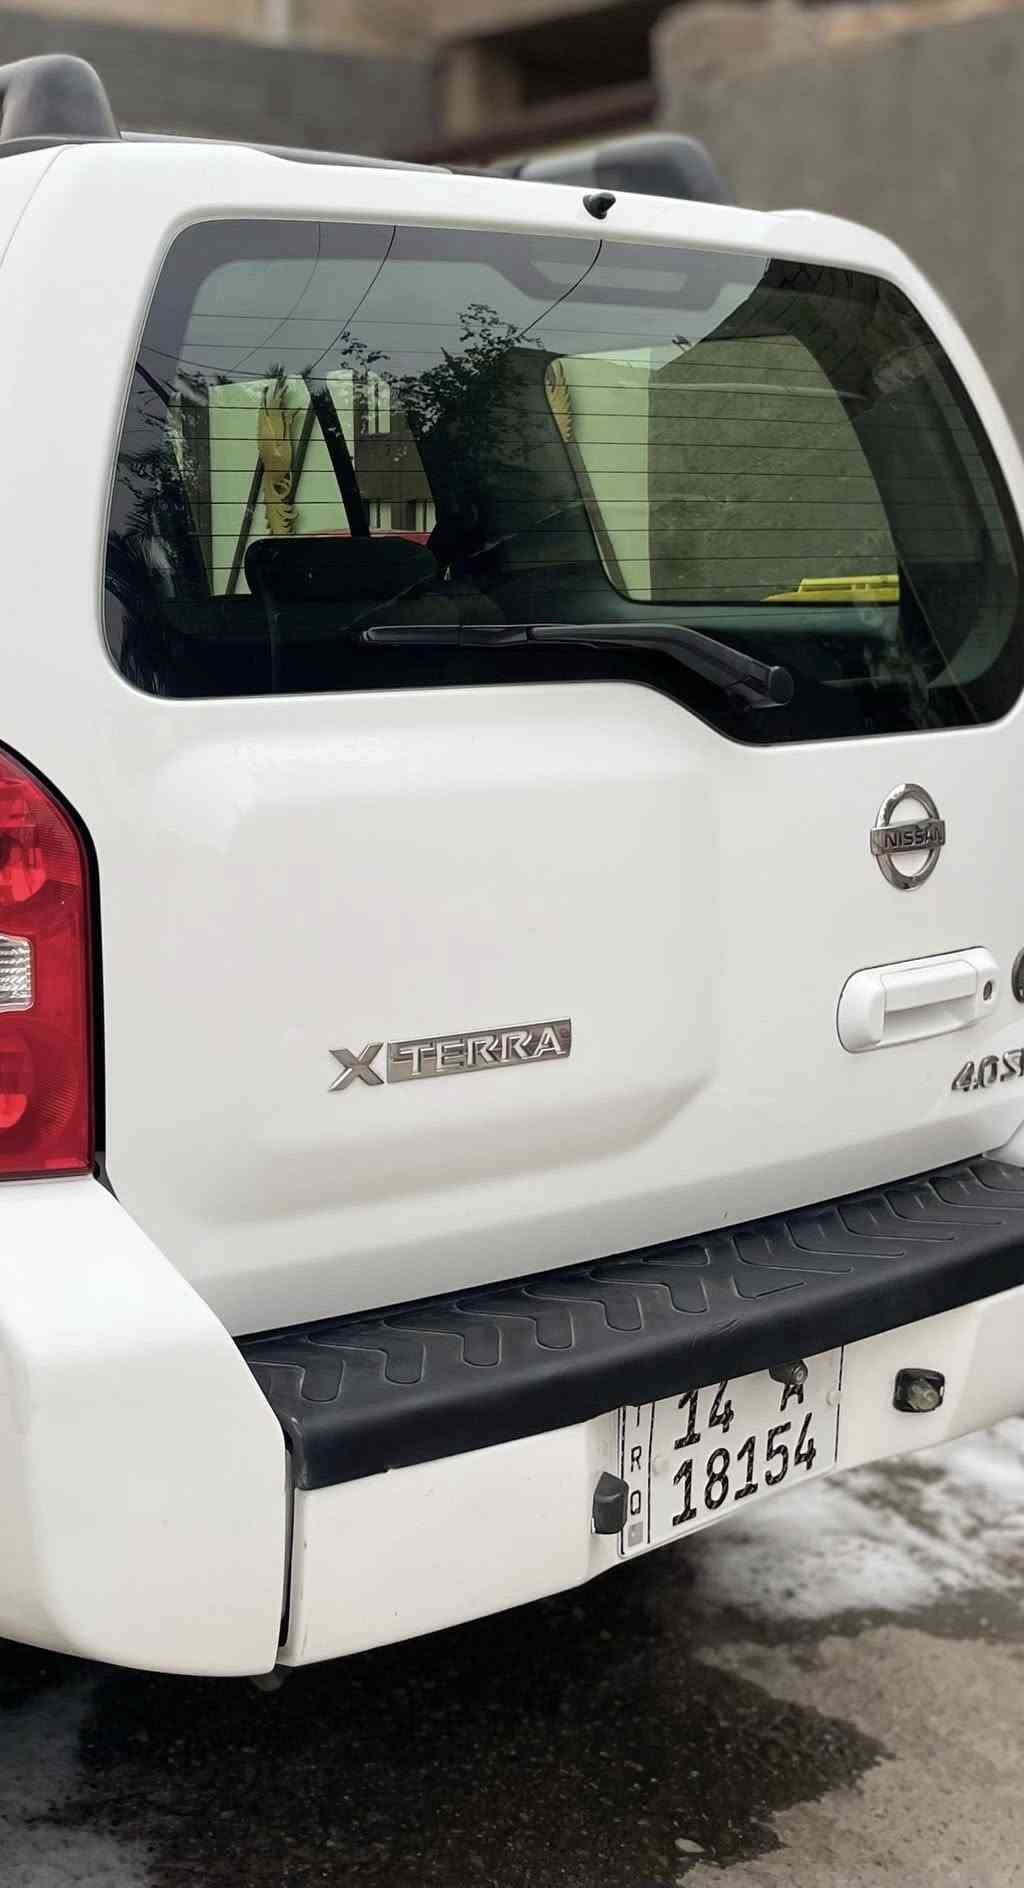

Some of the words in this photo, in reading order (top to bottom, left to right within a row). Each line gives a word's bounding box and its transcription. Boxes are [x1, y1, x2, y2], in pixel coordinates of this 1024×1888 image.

[883, 826, 943, 849] NISSAN
[673, 1378, 734, 1450] 14
[672, 1411, 817, 1527] 18154
